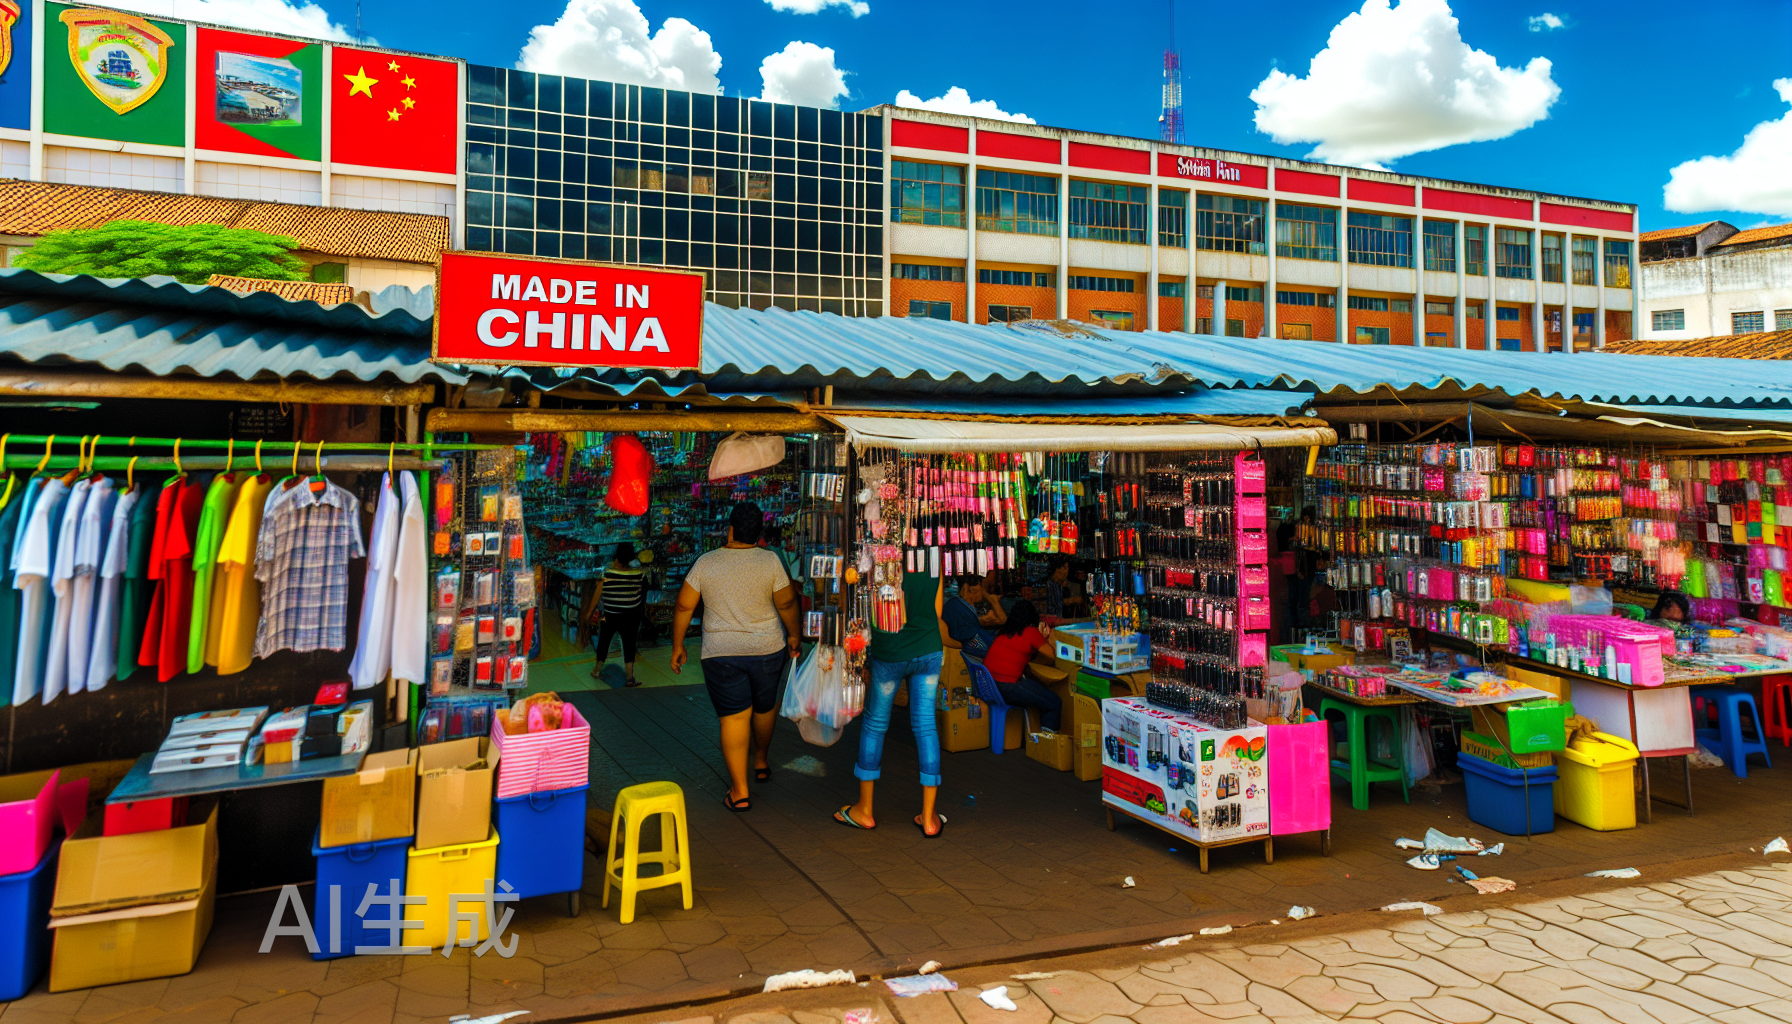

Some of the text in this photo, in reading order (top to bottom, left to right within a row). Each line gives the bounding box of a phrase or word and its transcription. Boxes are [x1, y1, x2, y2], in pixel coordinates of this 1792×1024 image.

[491, 273, 649, 309] MADE IN
[476, 308, 671, 353] CHINA
